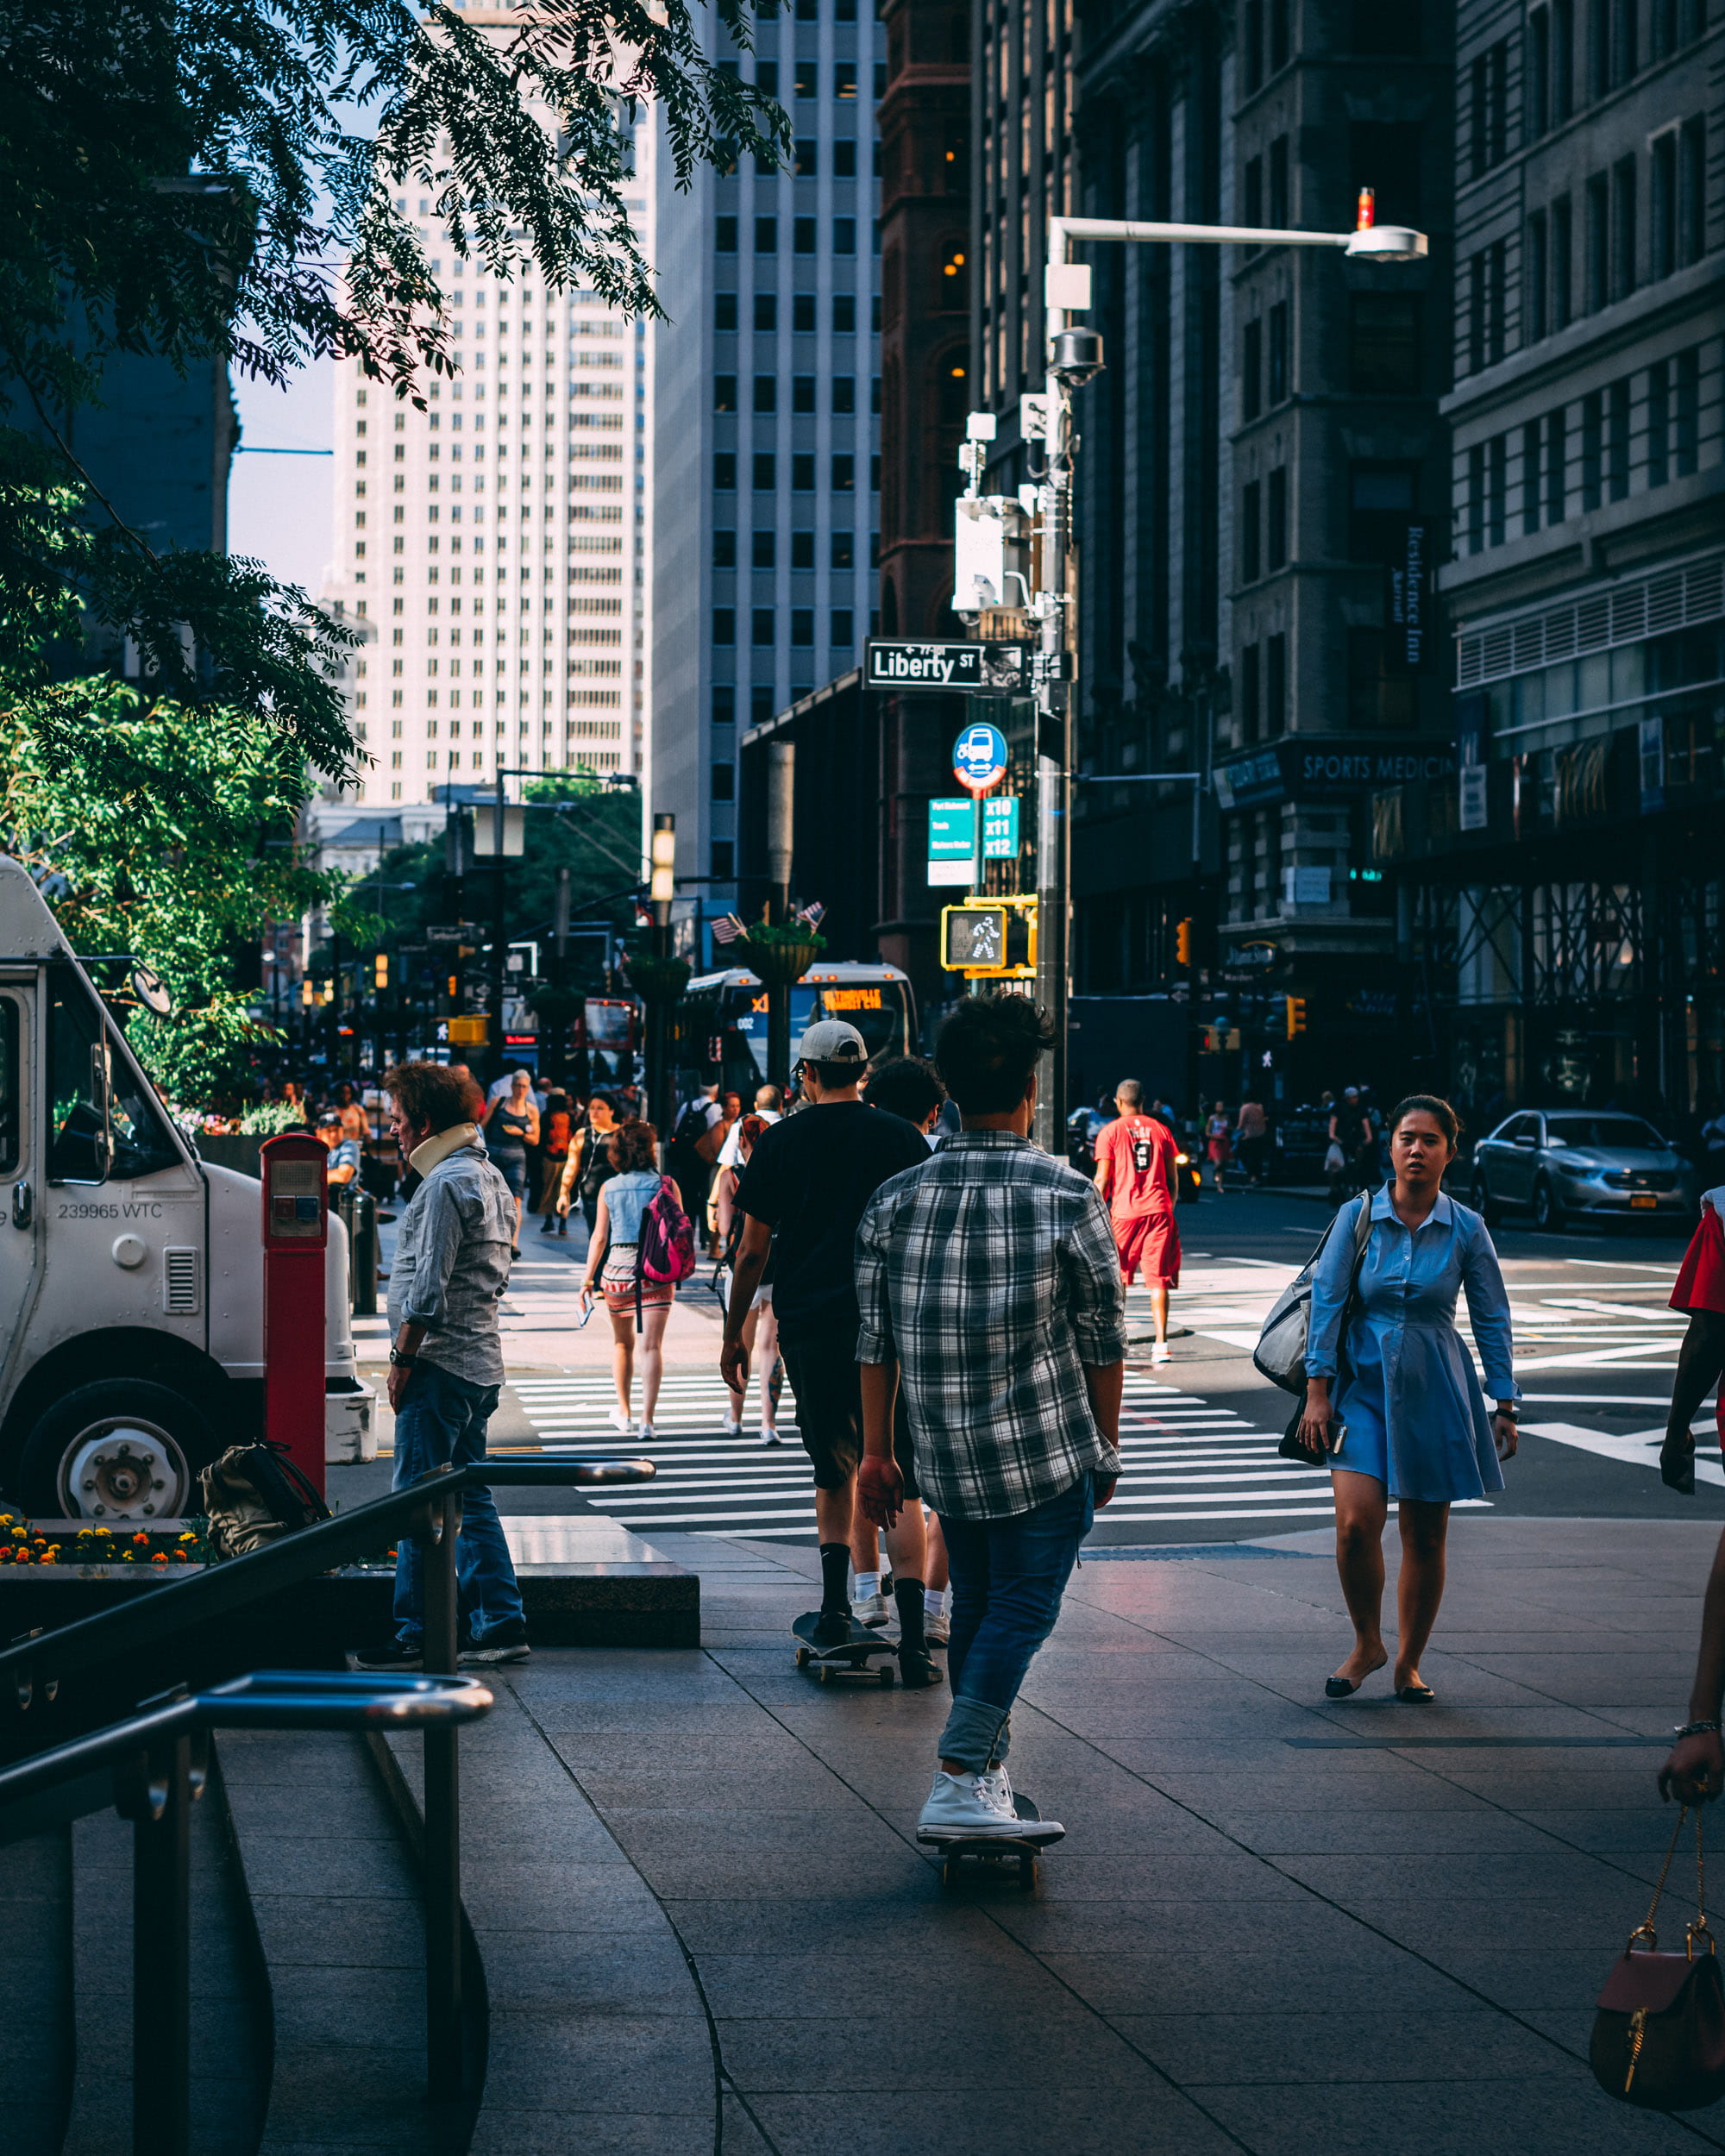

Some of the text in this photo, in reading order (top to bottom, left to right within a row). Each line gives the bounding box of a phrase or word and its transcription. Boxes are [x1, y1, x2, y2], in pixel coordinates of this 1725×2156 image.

[1408, 526, 1424, 663] Residence Inn
[875, 650, 975, 683] Liberty ST
[1302, 755, 1371, 780] SPORTS
[1377, 755, 1455, 780] MEDICIN
[986, 799, 1011, 816] x10
[986, 819, 1009, 836] x11
[985, 839, 1011, 856] x12
[58, 1204, 162, 1219] 239965 WTC
